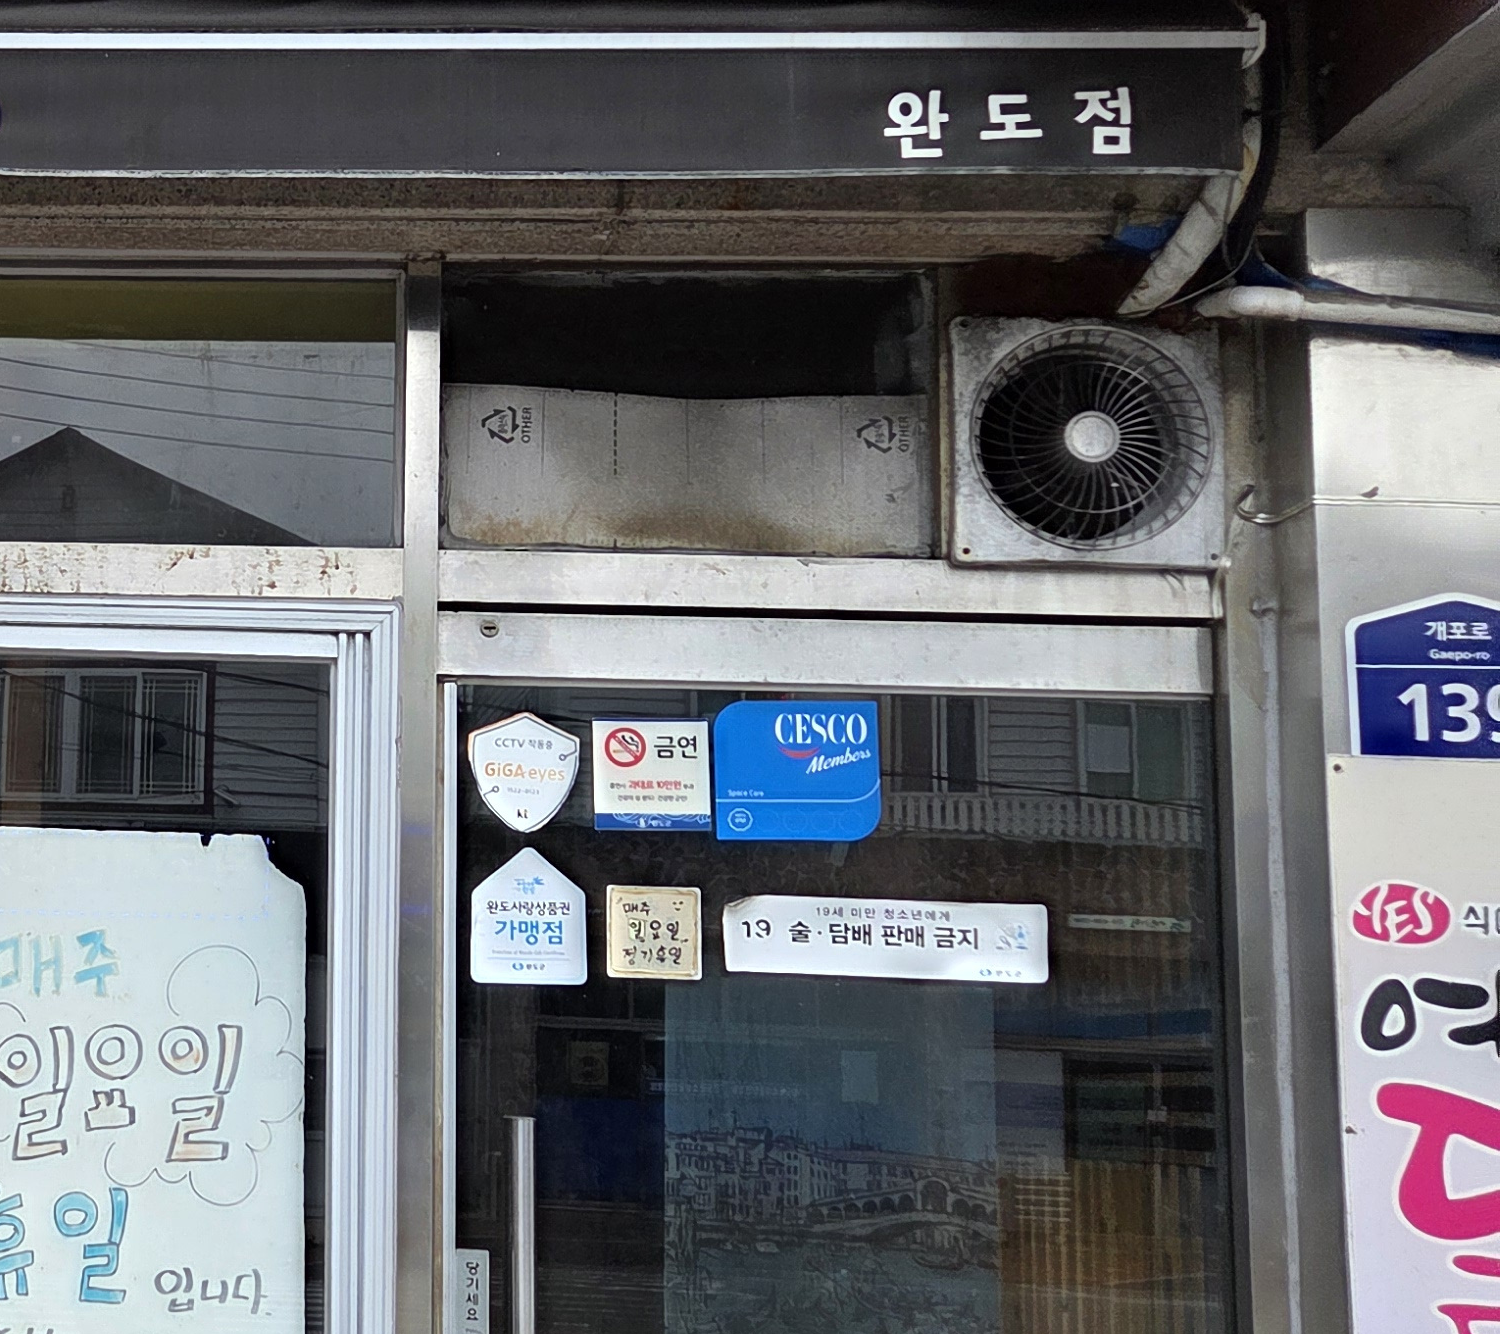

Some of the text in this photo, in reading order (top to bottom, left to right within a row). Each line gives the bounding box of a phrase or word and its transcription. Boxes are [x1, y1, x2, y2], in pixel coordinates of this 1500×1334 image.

[521, 407, 533, 444] OTHER
[1425, 621, 1493, 642] 개포로
[1428, 648, 1491, 662] Gaepo-ro
[774, 713, 868, 745] CESCO
[494, 737, 526, 749] CCTV
[654, 735, 698, 760] 금연
[486, 899, 571, 917] 완도사랑상품권
[622, 901, 651, 917] 매주
[815, 906, 951, 923] 19세 미만 청소년에게
[1353, 883, 1436, 943] YES
[1462, 905, 1500, 936] 식
[495, 919, 563, 946] 가맹점
[741, 918, 772, 939] 19
[881, 924, 925, 948] 판매
[932, 926, 979, 950] 금지
[466, 1261, 480, 1322] 당기세요
